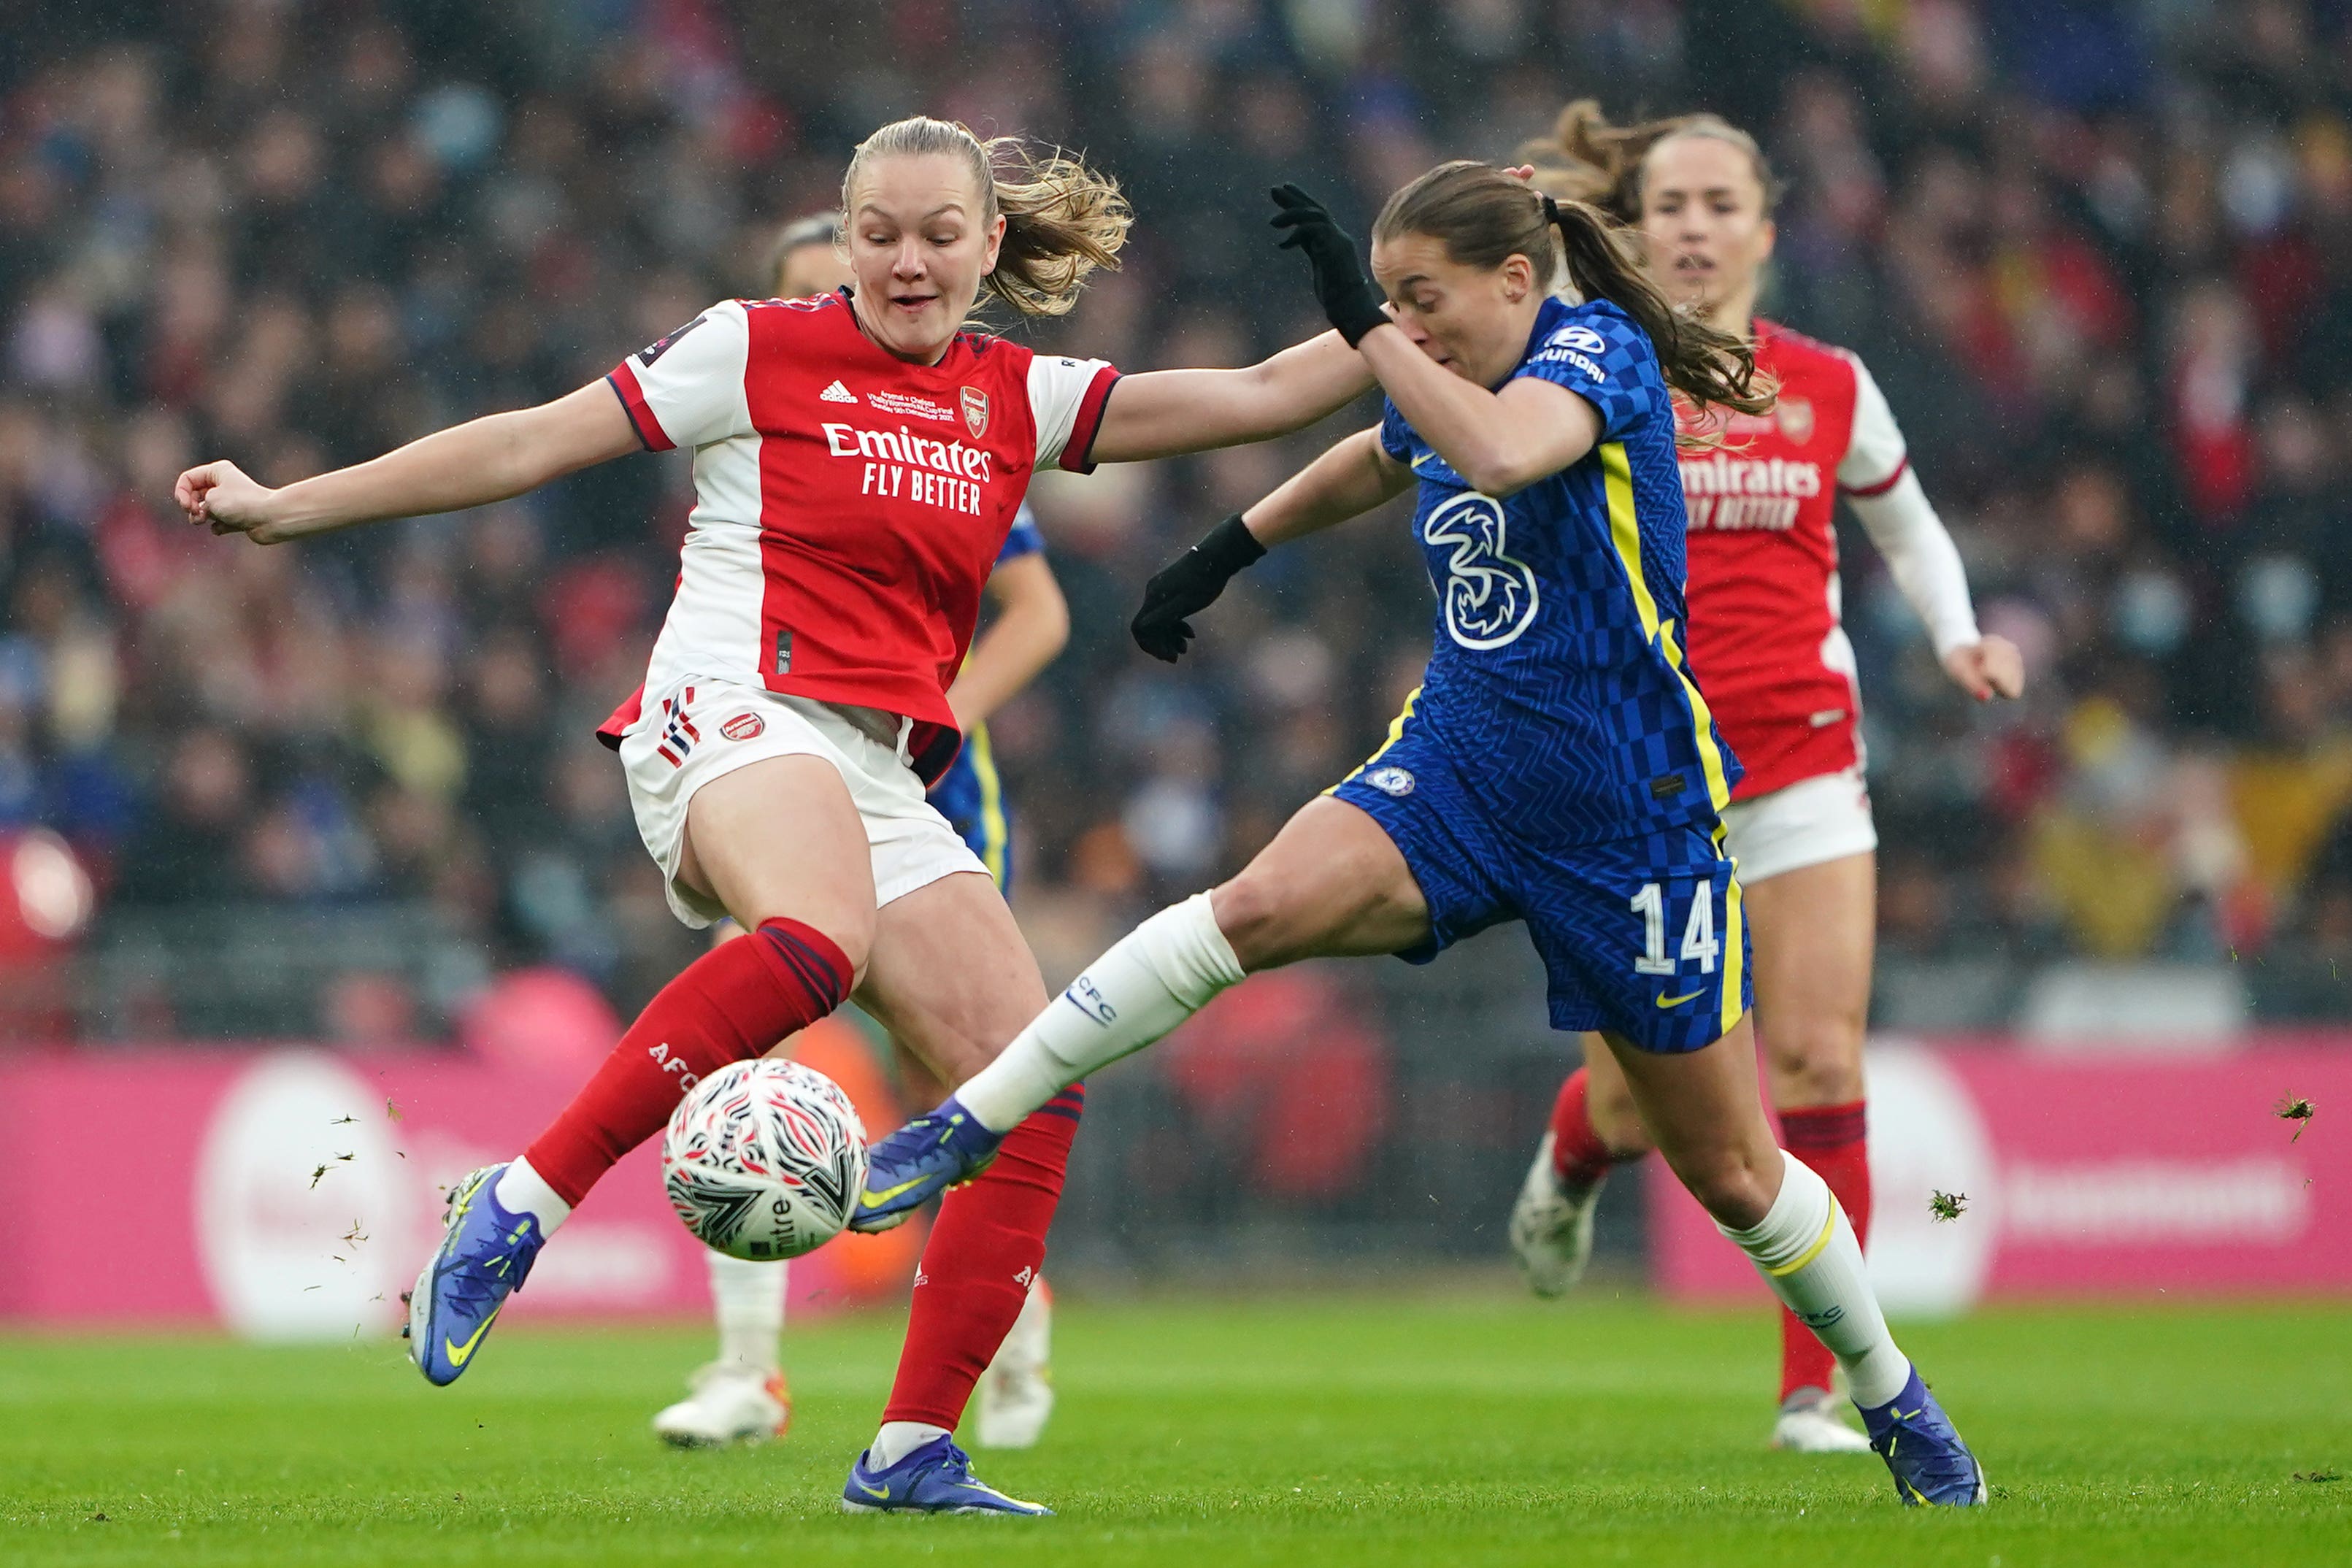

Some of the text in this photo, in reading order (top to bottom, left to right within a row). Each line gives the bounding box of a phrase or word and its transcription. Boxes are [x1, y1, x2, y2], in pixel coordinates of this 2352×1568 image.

[820, 393, 858, 404] adidas
[820, 423, 991, 483] Emirates
[1679, 451, 1822, 497] mirates
[861, 463, 981, 516] FLY BETTER
[1631, 880, 1718, 975] 14
[1079, 977, 1117, 1022] CFC
[649, 1042, 699, 1093] AFC
